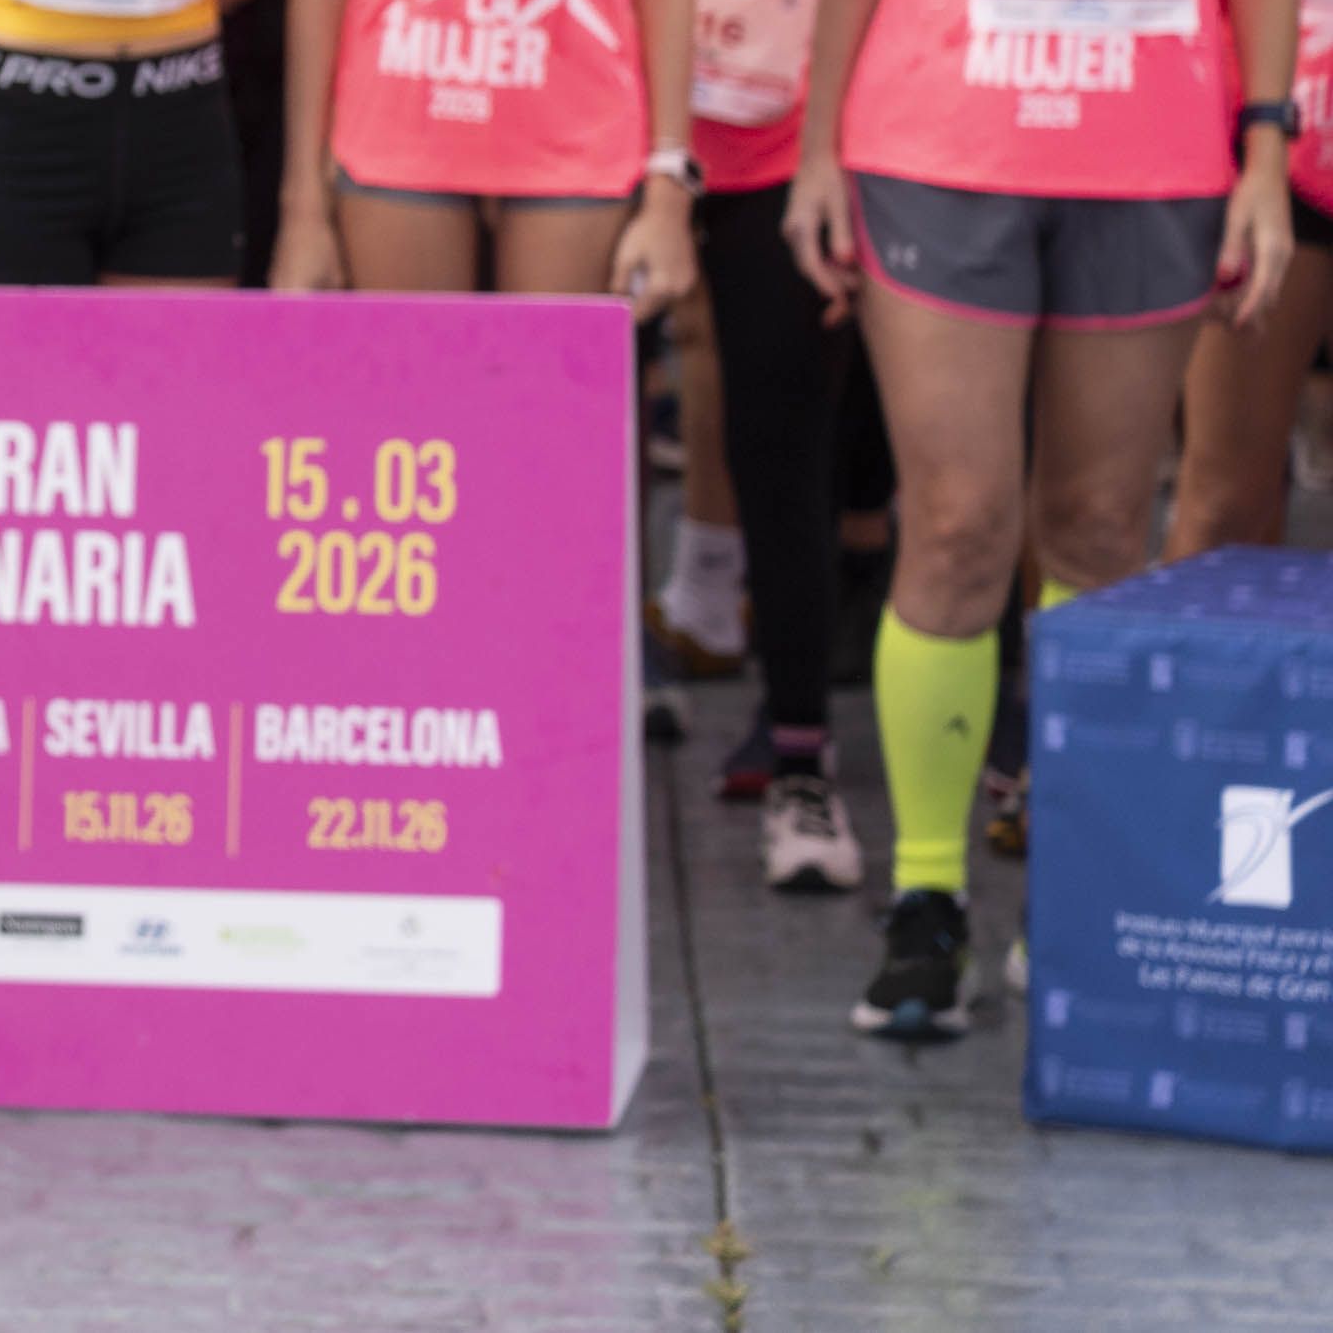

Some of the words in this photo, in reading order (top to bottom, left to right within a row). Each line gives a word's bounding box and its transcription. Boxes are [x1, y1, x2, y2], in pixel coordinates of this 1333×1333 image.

[131, 42, 223, 97] NIKE
[965, 29, 1135, 93] MUJER
[276, 529, 439, 616] 2026
[44, 698, 216, 760] SEVILLA
[253, 704, 503, 768] BARCELONA
[63, 789, 194, 846] 15.11.26
[306, 797, 449, 853] 22.11.26
